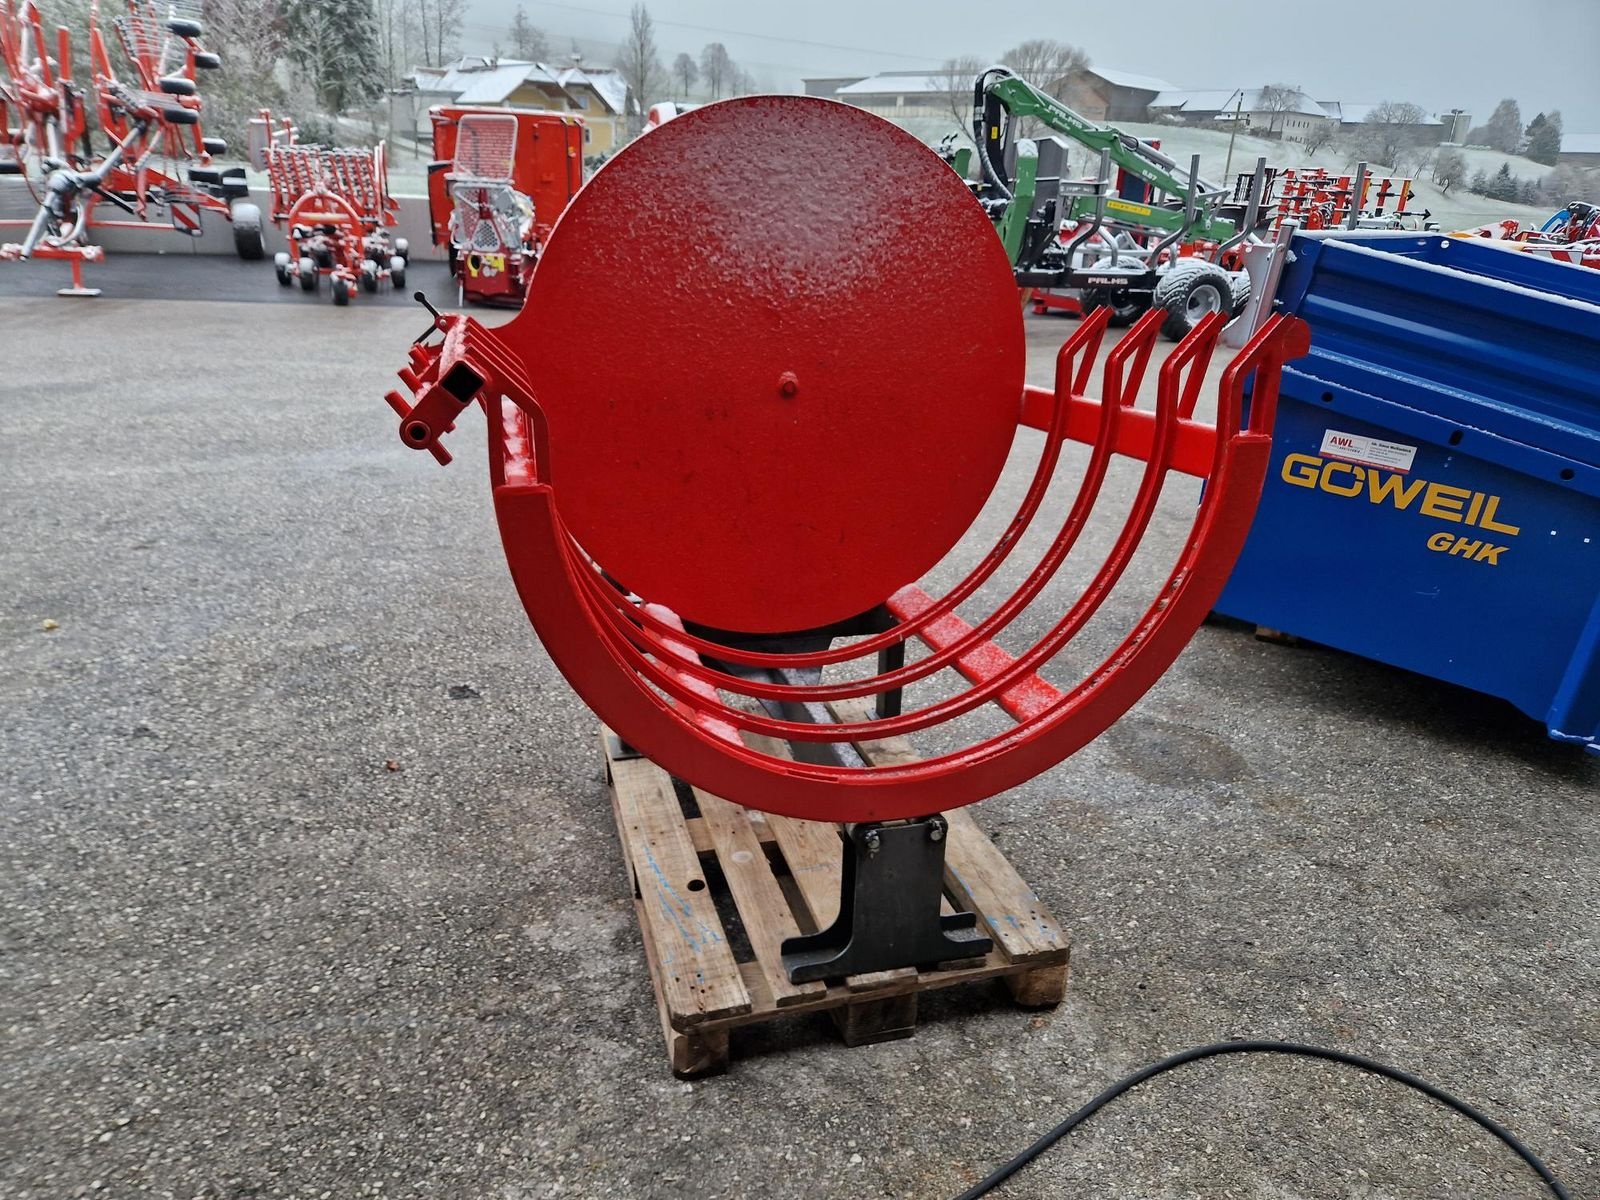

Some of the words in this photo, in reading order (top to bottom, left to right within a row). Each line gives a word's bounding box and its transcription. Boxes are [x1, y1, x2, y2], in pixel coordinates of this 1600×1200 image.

[1087, 276, 1128, 285] PALMS
[1329, 436, 1354, 448] AWL
[1426, 532, 1510, 566] GHK
